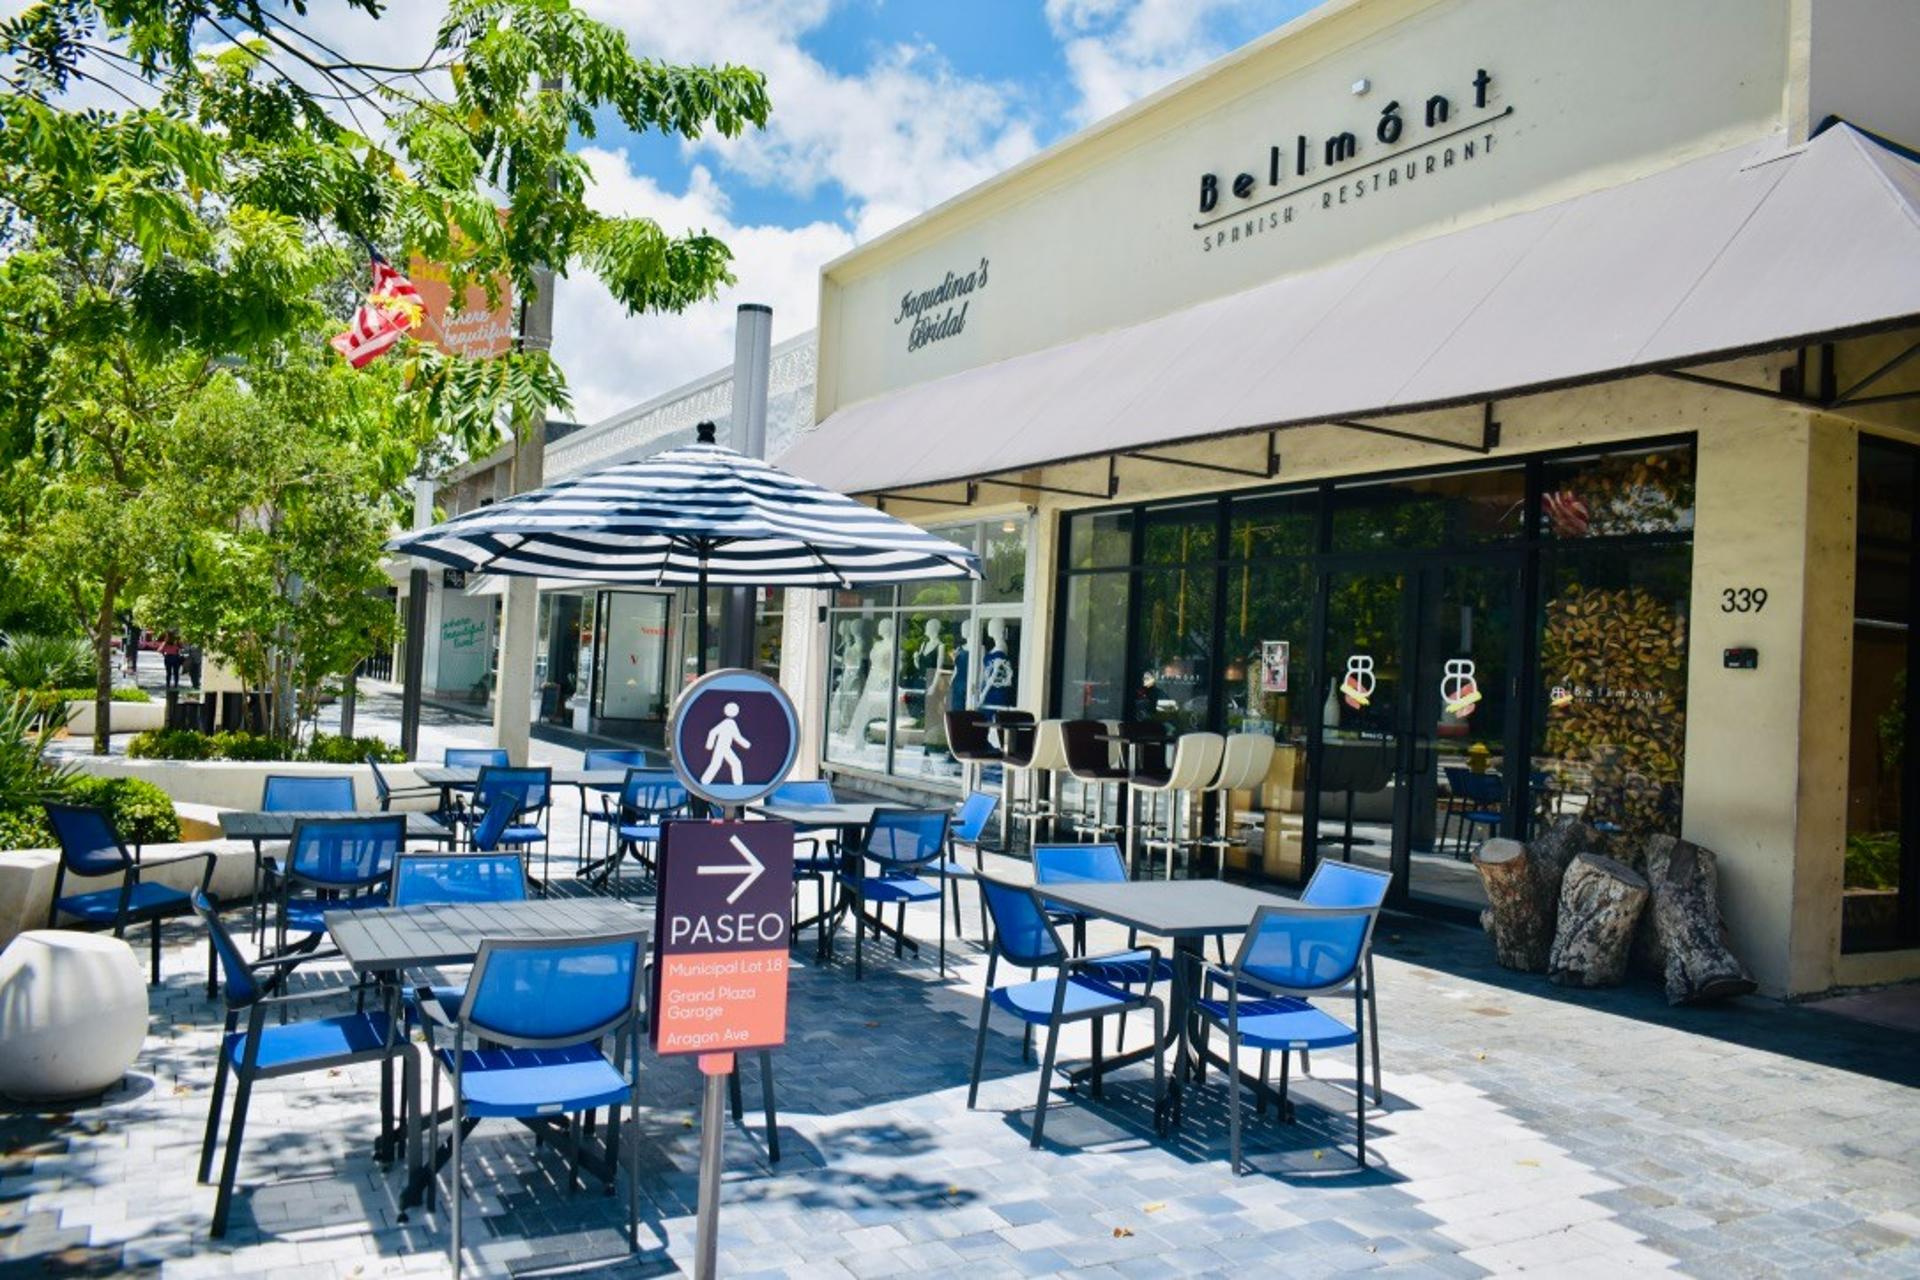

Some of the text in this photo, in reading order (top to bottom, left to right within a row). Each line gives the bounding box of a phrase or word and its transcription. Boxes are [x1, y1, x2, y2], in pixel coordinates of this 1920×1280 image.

[1199, 69, 1491, 213] Bellmónt
[1203, 134, 1494, 251] SPANISH RESTAURANT
[908, 300, 969, 352] Bridal
[1721, 588, 1768, 613] 339
[670, 913, 784, 945] PASEO
[669, 959, 783, 978] Municipal Lot 18
[668, 986, 756, 1003] Grand Plaza
[667, 1005, 724, 1021] Garage
[666, 1028, 750, 1047] Aragon Ave
